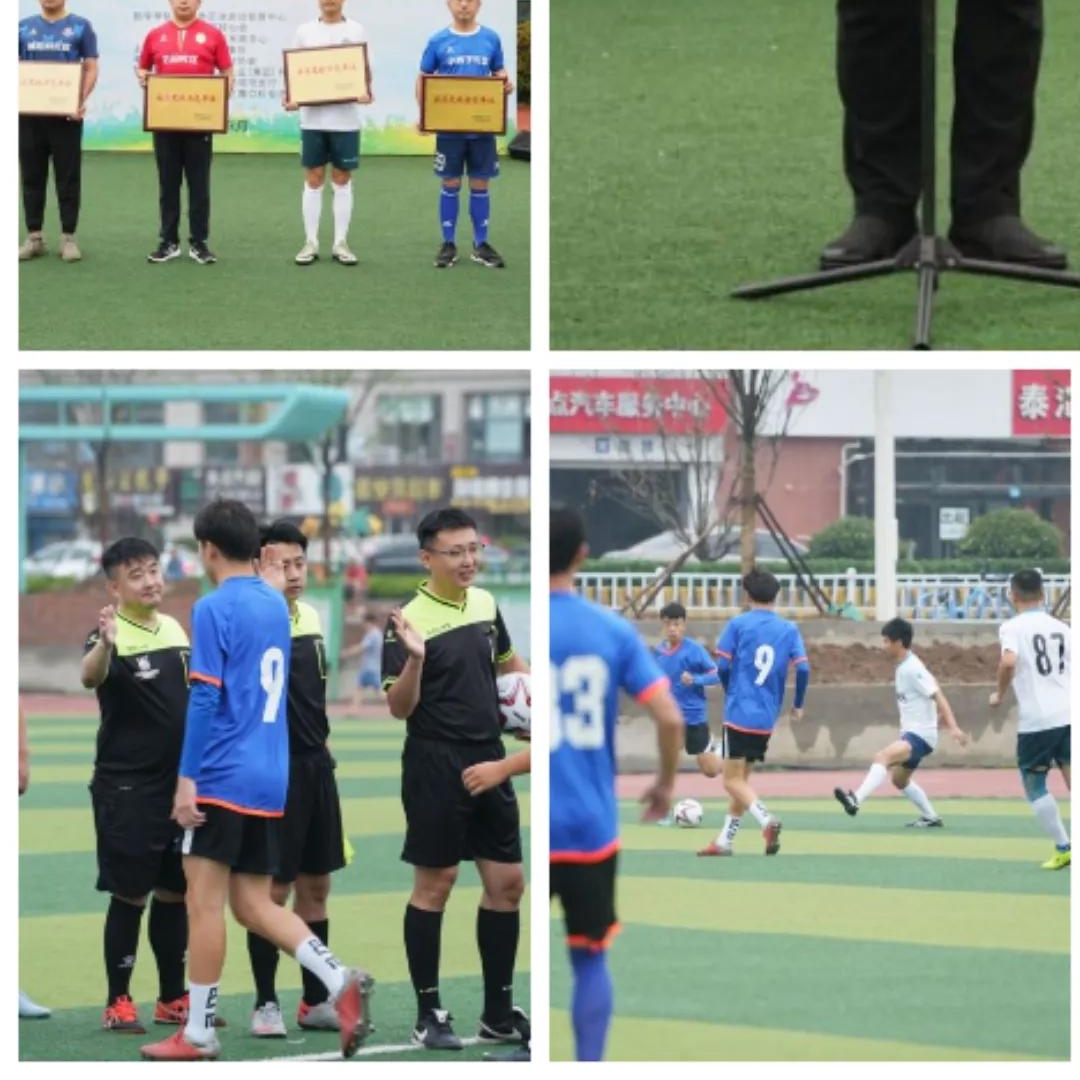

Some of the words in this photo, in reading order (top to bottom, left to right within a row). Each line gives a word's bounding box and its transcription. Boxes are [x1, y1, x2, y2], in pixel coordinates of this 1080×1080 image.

[753, 645, 775, 687] 9
[1033, 632, 1066, 677] 87
[260, 647, 286, 724] 9
